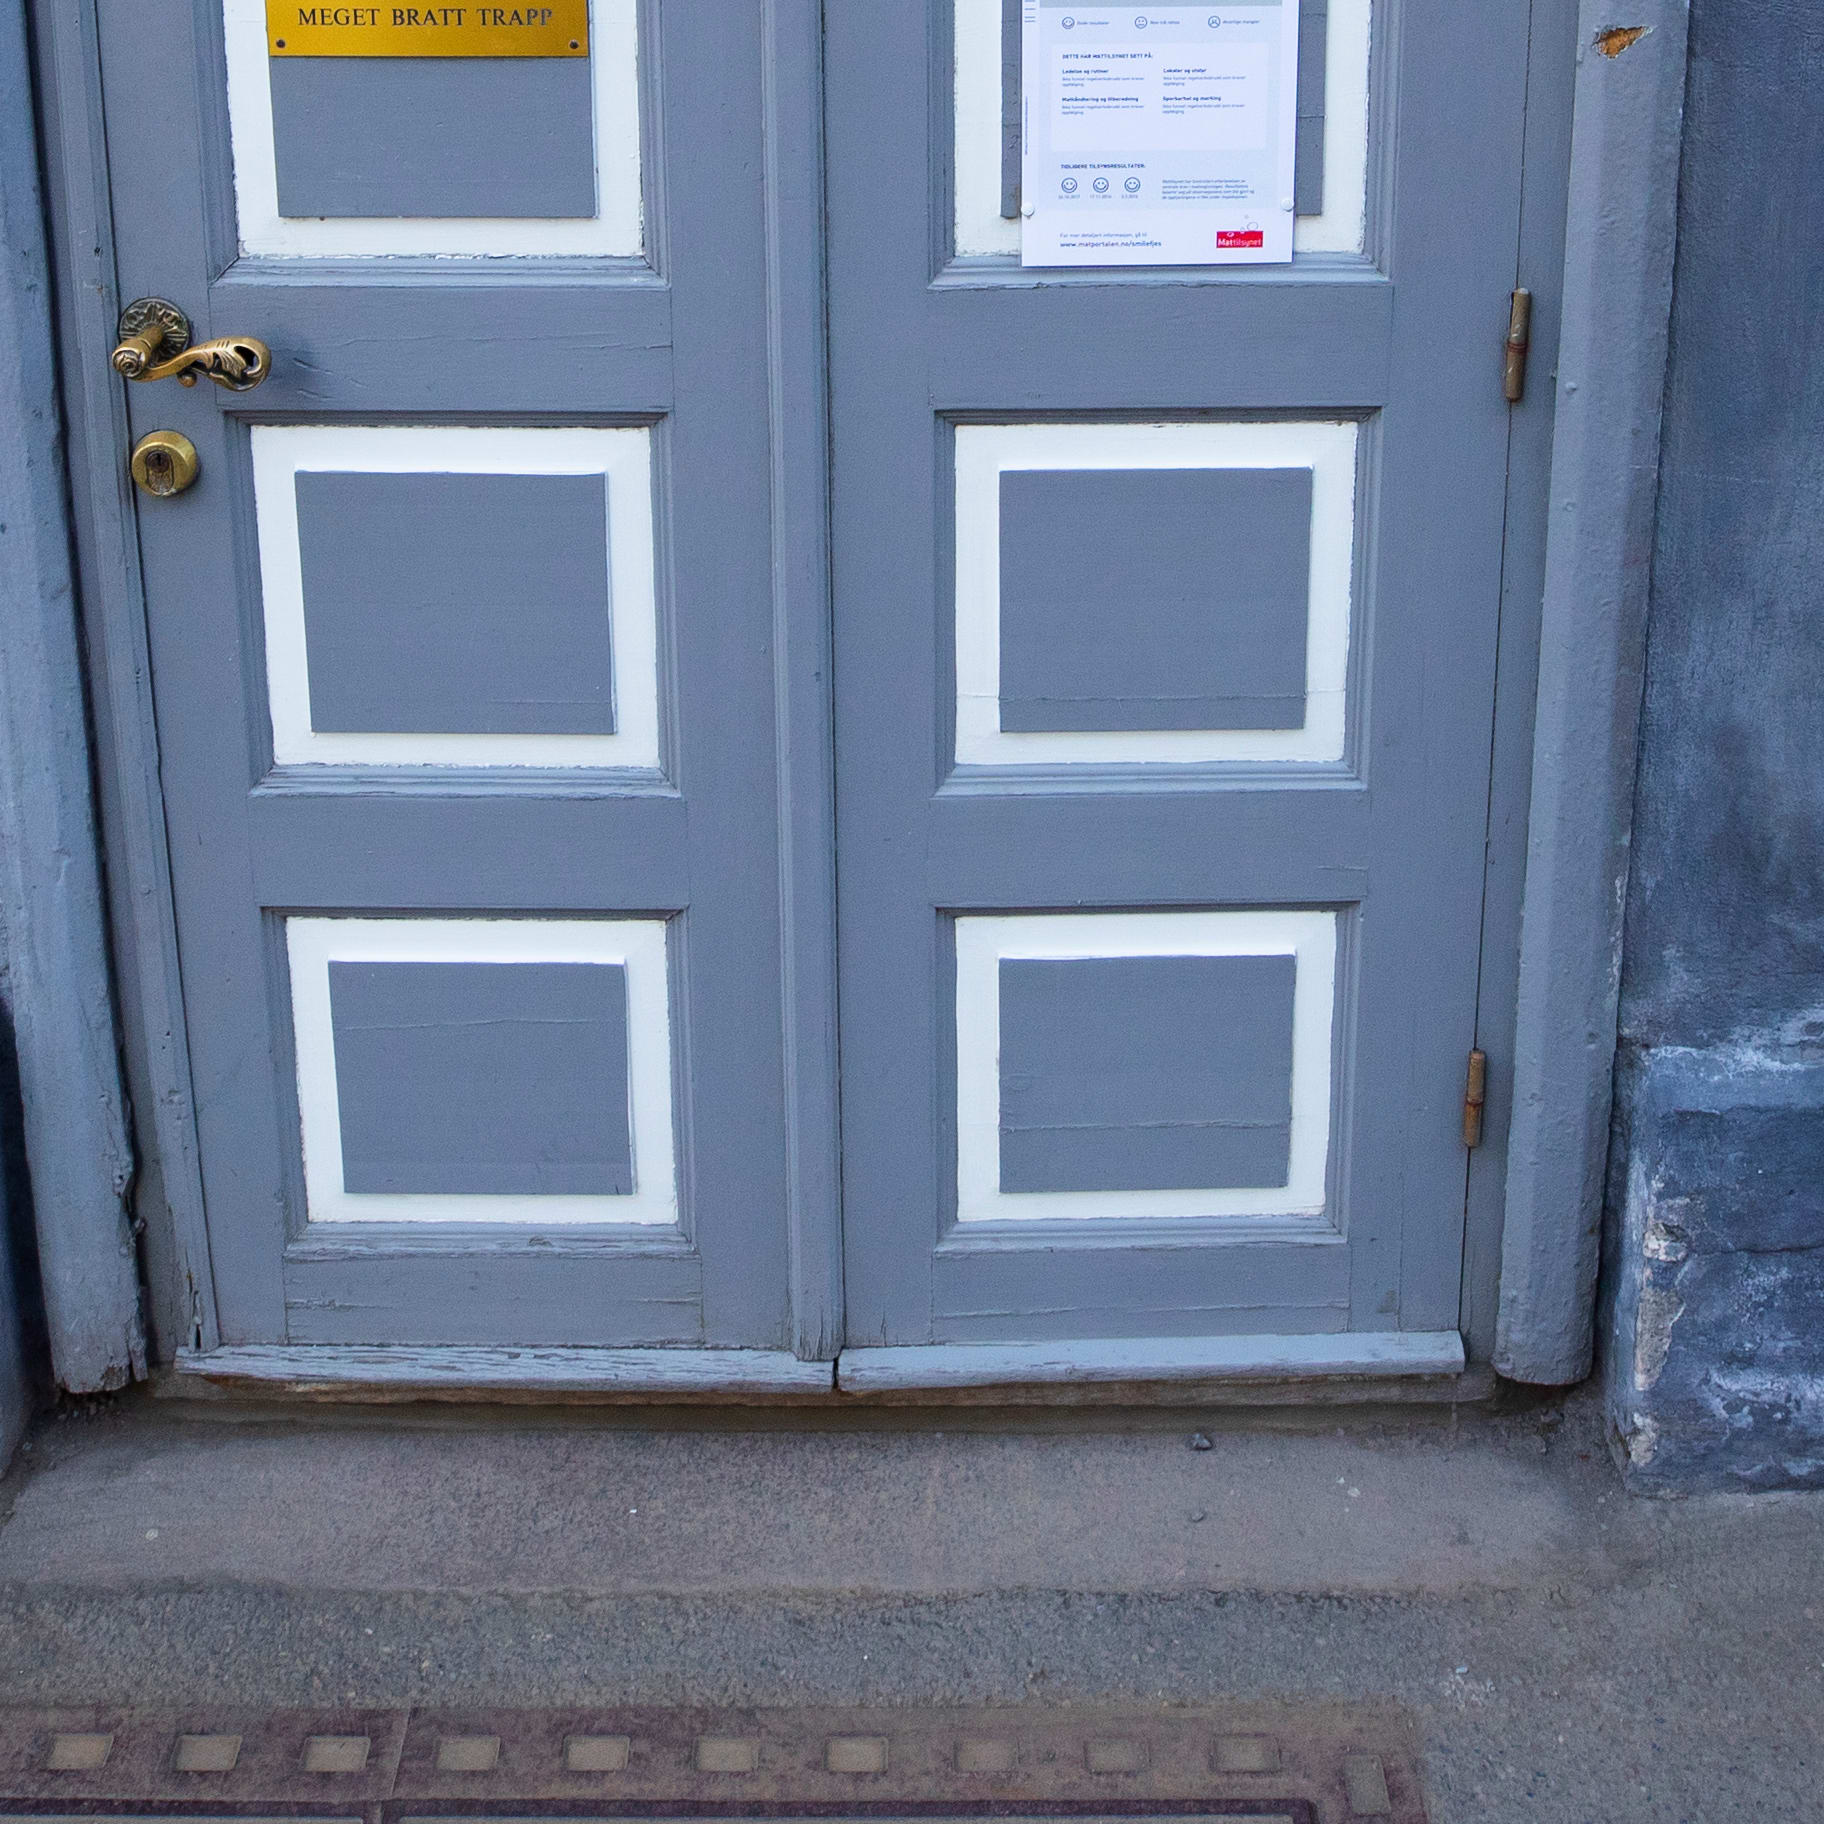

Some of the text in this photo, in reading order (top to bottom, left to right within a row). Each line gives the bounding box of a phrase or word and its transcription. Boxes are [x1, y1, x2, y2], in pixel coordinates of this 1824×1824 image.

[297, 8, 553, 27] MEGET BRATT TRAPP
[1217, 238, 1262, 248] Mattilsynet
